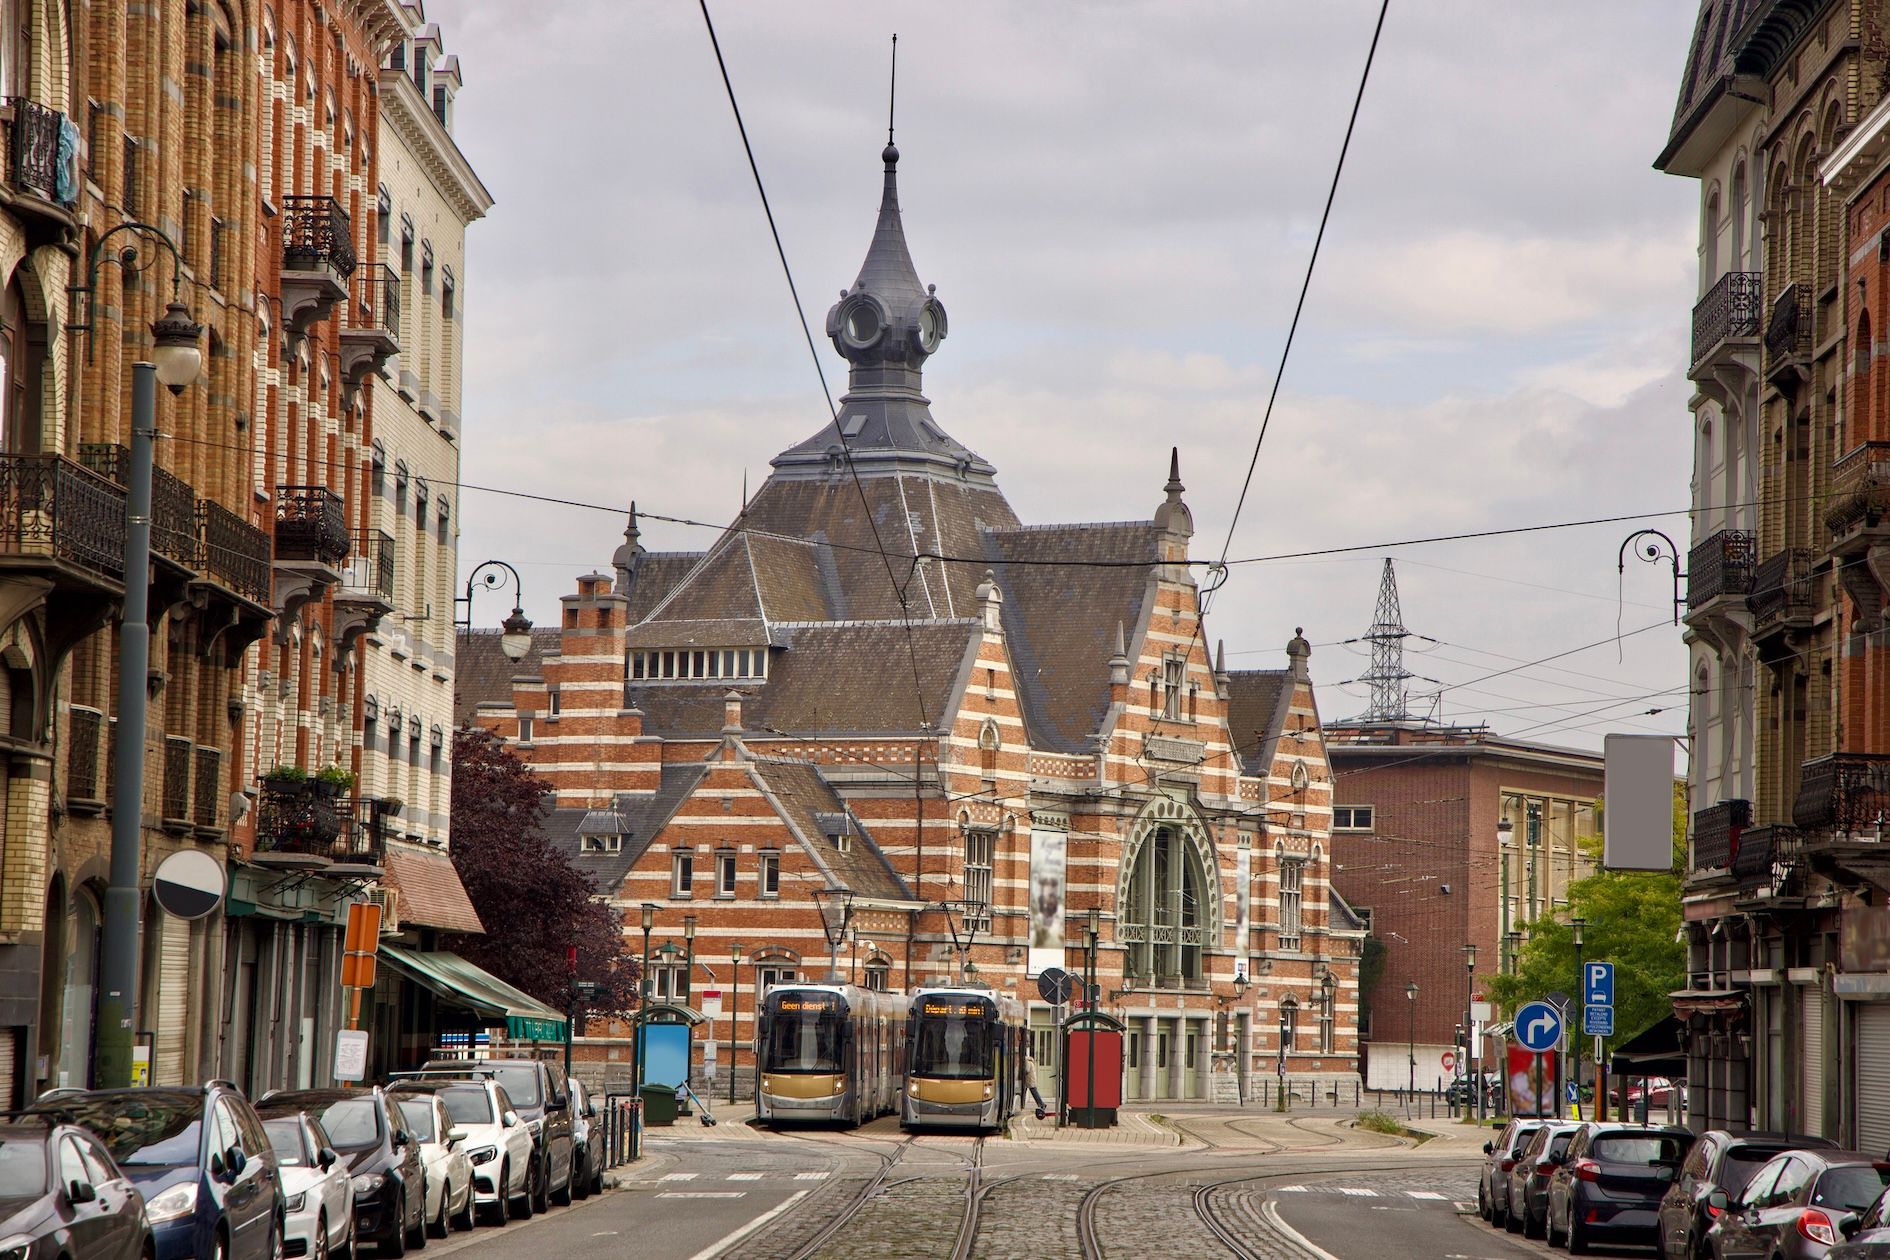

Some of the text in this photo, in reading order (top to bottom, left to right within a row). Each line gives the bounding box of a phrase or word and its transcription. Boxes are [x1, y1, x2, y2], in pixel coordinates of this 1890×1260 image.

[1591, 965, 1607, 988] P
[781, 1001, 800, 1010] Geen
[802, 1001, 825, 1010] dienst
